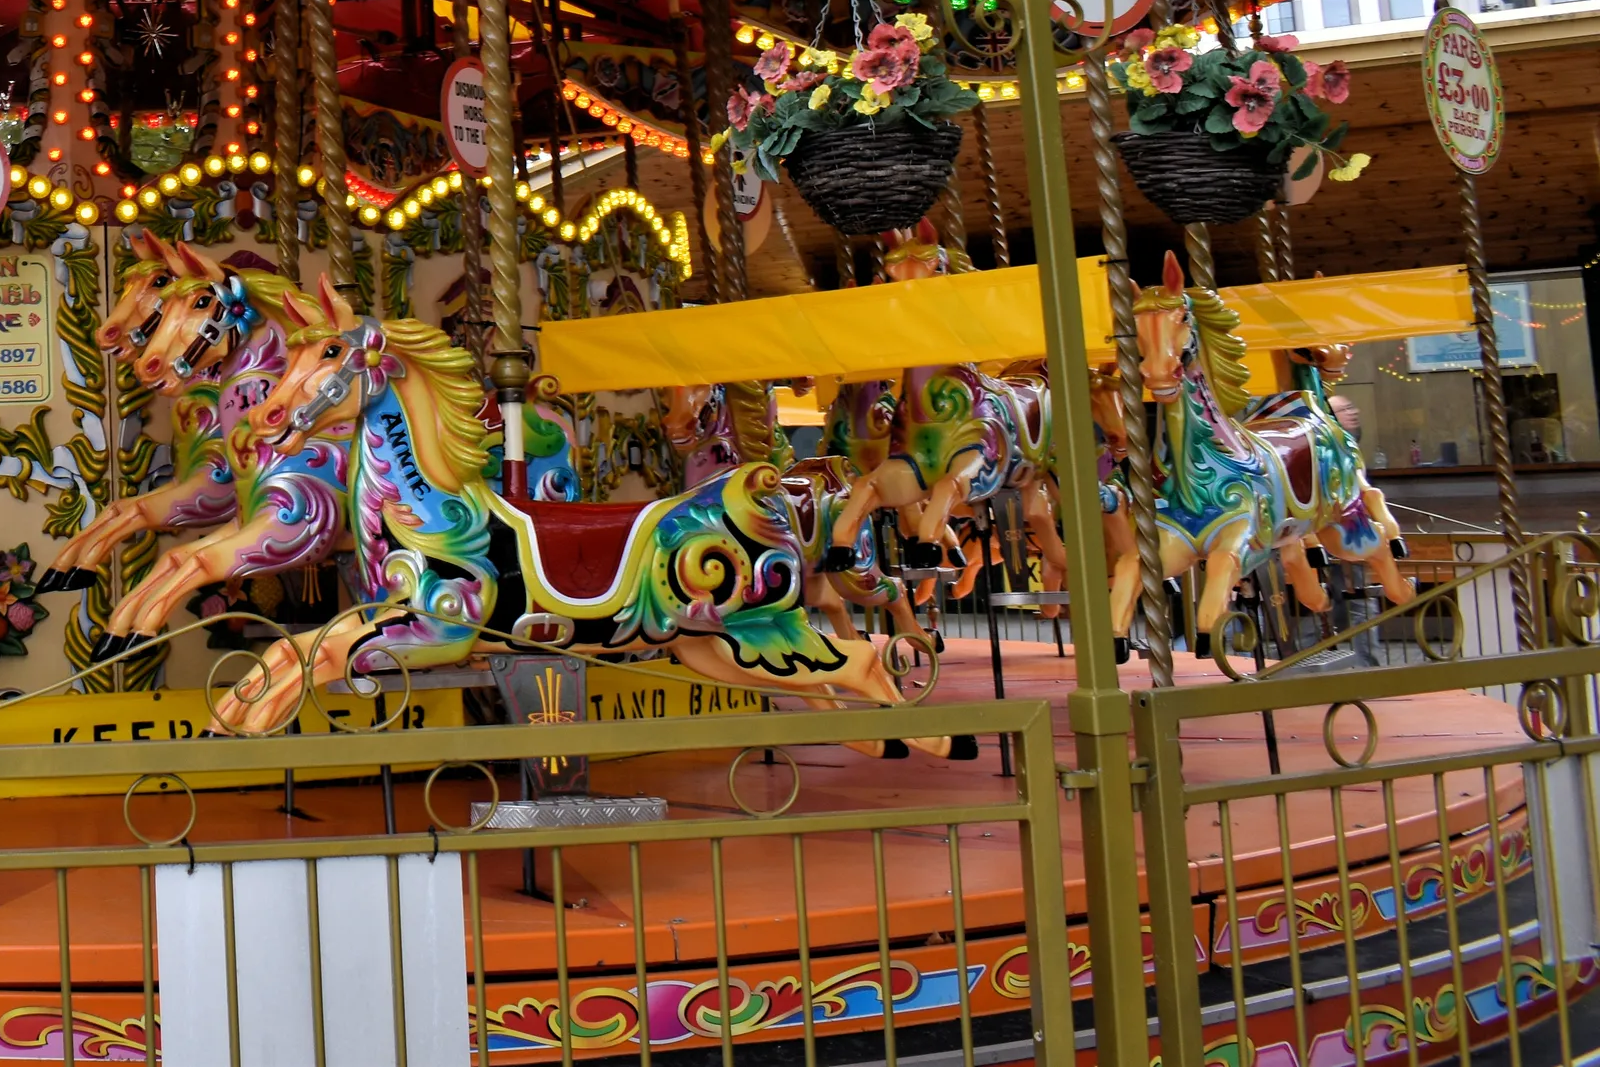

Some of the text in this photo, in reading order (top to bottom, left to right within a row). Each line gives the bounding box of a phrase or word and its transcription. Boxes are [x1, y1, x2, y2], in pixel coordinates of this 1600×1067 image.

[1442, 33, 1483, 69] FARE
[463, 105, 487, 123] HORS
[1452, 108, 1480, 126] EACH
[454, 125, 464, 141] TO
[465, 127, 480, 144] THE
[1447, 120, 1486, 141] PERSON
[380, 412, 431, 502] ANNIE
[590, 689, 666, 721] TAND
